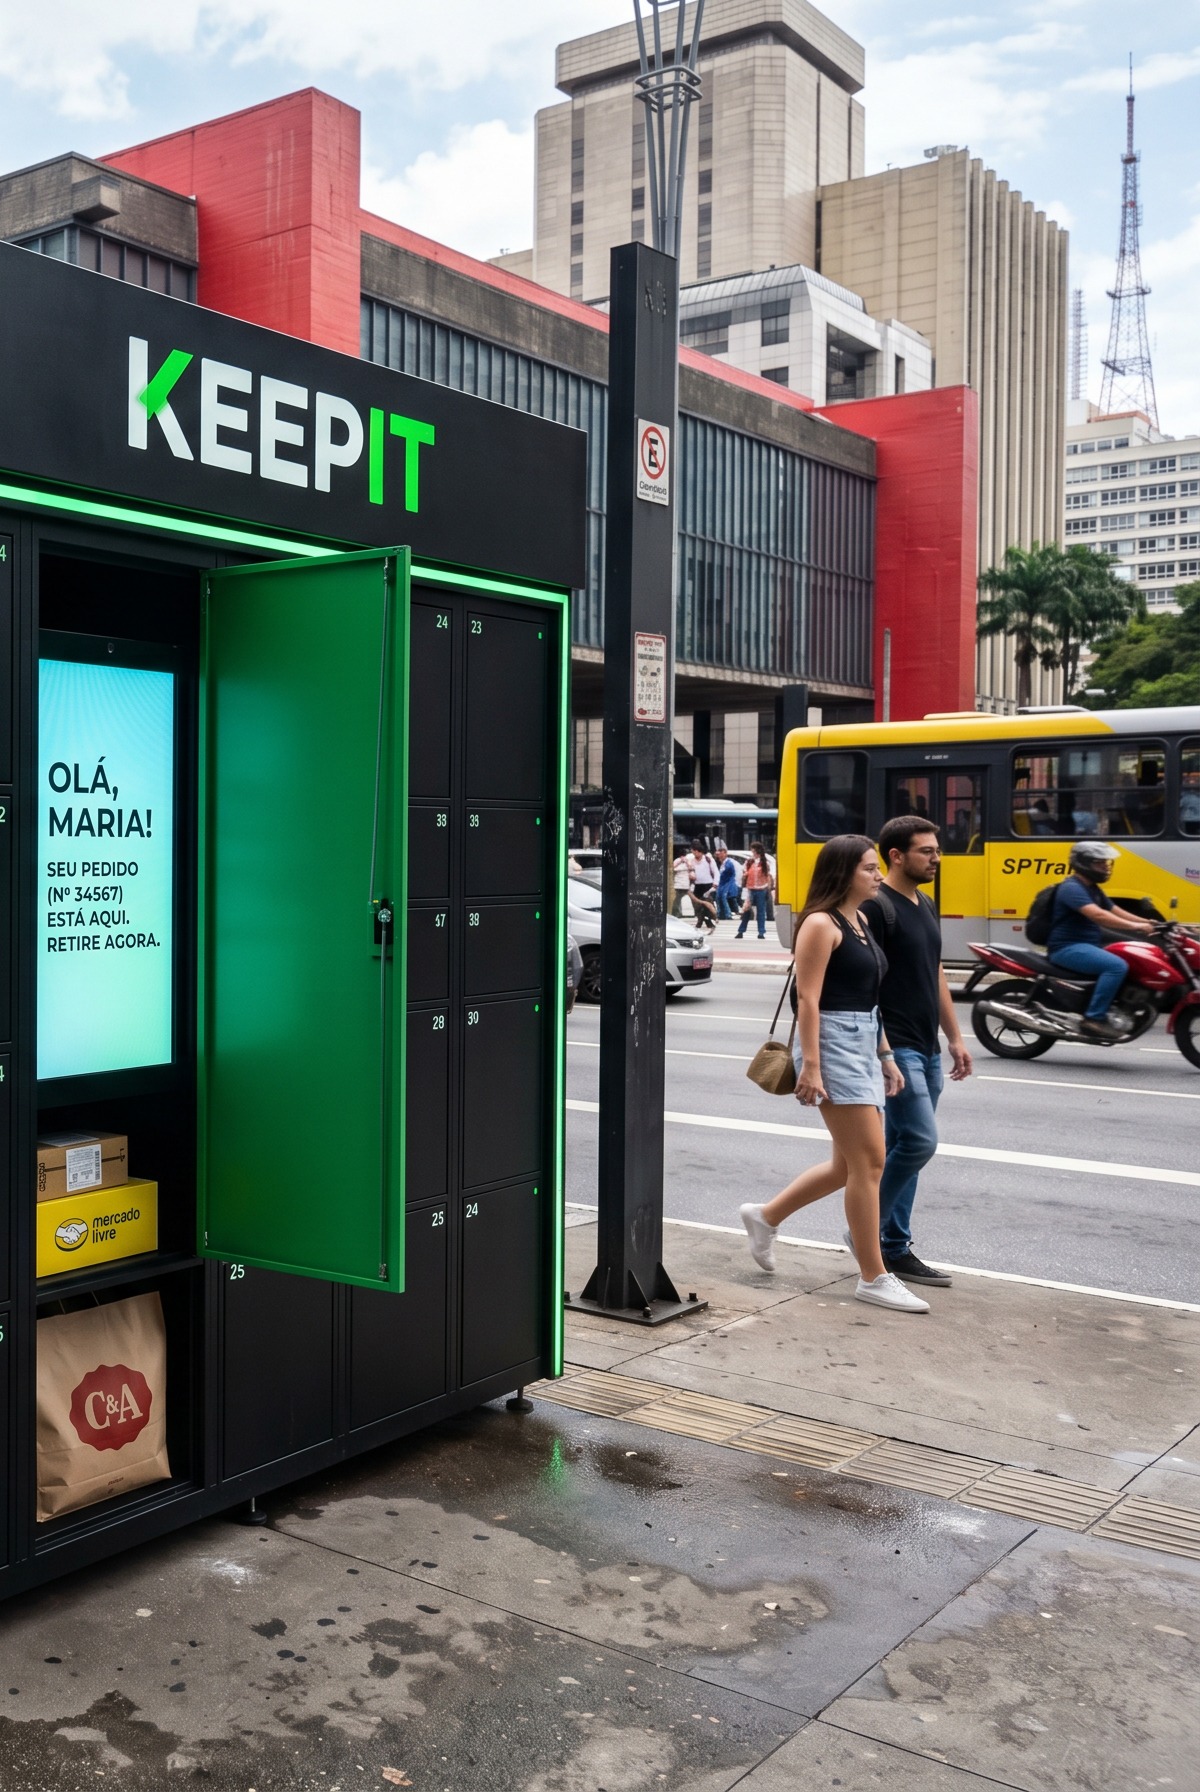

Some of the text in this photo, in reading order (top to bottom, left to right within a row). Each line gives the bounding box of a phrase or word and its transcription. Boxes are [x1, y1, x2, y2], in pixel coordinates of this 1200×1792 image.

[128, 336, 435, 513] KEEPIT
[436, 614, 449, 629] 24
[471, 619, 482, 635] 23
[48, 756, 119, 801] OLÁ,
[49, 806, 152, 838] MARIA!
[47, 861, 139, 877] SEU PEDIDO
[74, 885, 123, 904] 34567)
[47, 907, 130, 928] ESTÁ AQUI.
[47, 932, 161, 953] RETIRE AGORA.
[467, 1010, 479, 1026] 30
[92, 1207, 140, 1229] mercado
[431, 1210, 444, 1227] 25
[465, 1202, 479, 1219] 24
[92, 1227, 117, 1244] livre
[229, 1263, 245, 1280] 25
[84, 1383, 144, 1430] C&A
